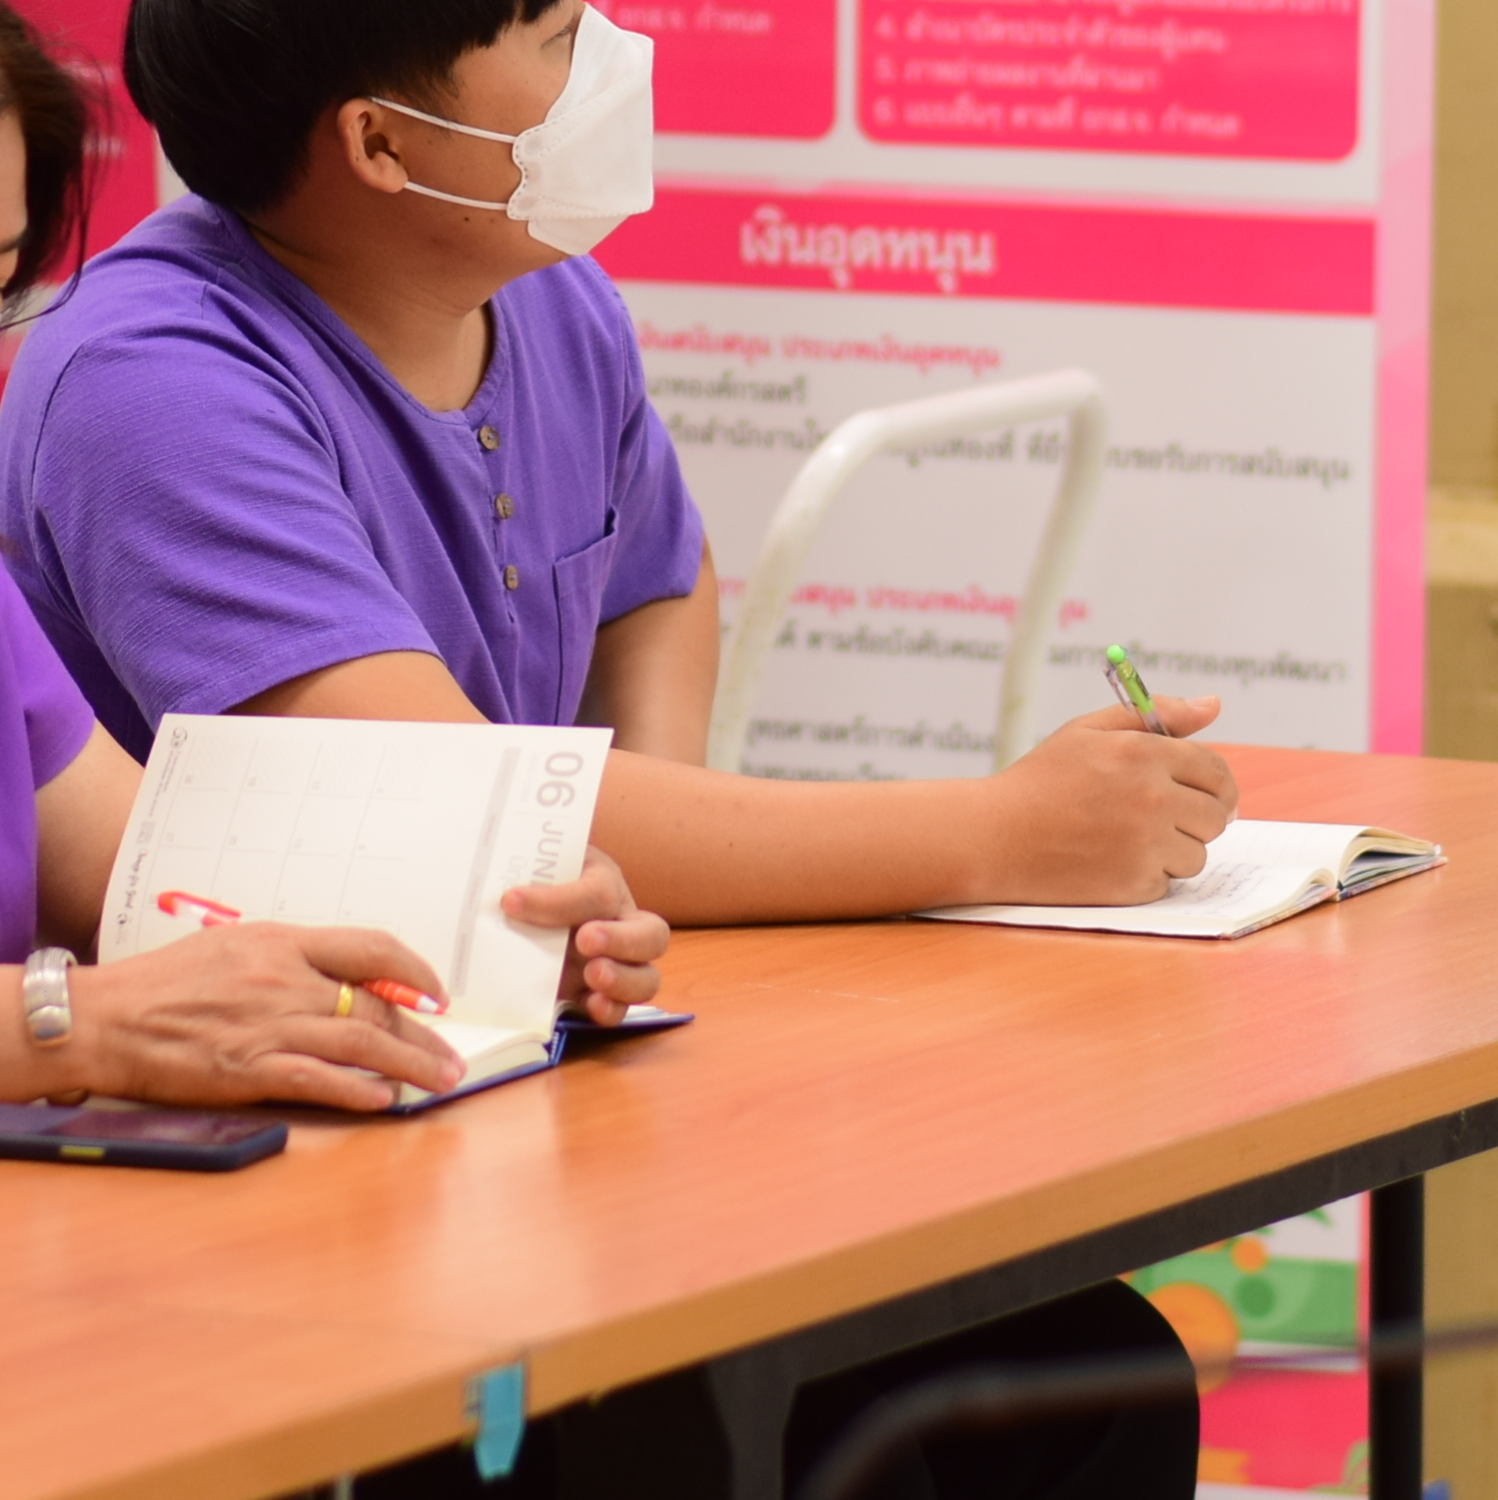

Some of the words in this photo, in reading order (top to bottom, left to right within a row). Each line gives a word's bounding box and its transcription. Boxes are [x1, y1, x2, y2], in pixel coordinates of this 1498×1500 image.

[739, 207, 995, 290] เงินอุดหนุน
[535, 751, 584, 808] 06
